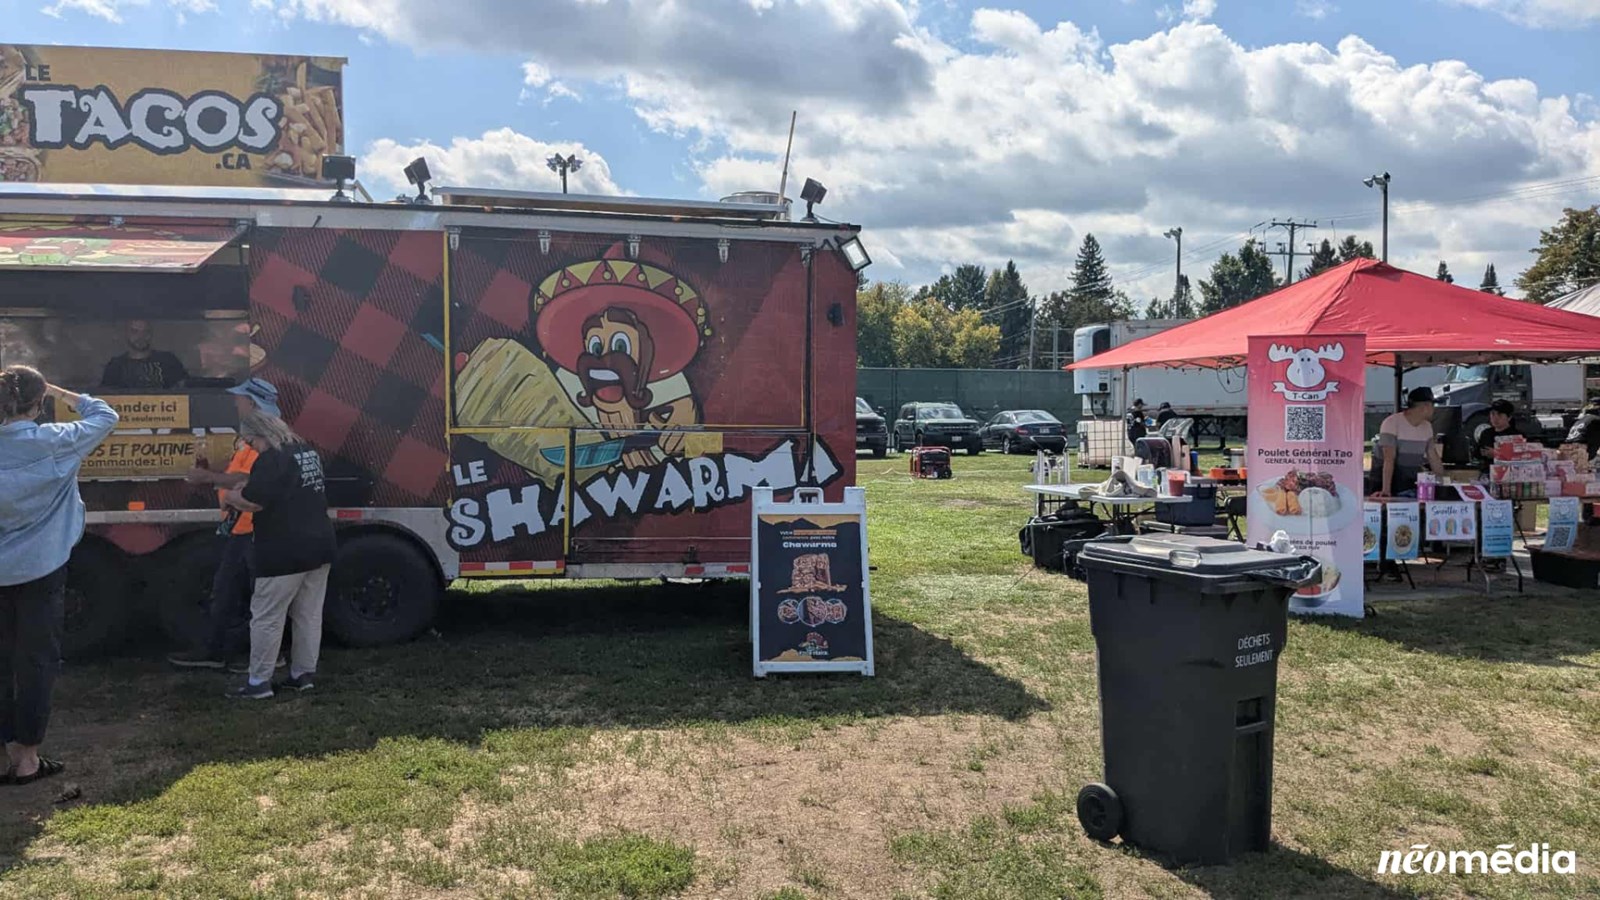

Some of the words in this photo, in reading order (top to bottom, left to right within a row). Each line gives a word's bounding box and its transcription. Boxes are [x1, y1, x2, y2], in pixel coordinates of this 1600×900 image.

[25, 64, 51, 81] LE
[23, 88, 279, 149] TACOS
[215, 155, 251, 170] .CA
[1292, 392, 1319, 400] T-Can
[160, 401, 177, 413] ici
[109, 443, 129, 457] ET
[131, 443, 195, 457] POUTINE
[1258, 449, 1290, 457] Poulet
[1292, 448, 1331, 458] Général
[1333, 449, 1353, 458] Tao
[159, 457, 174, 466] ici
[453, 460, 488, 486] LE
[1237, 633, 1271, 650] DÉCHETS
[1234, 650, 1273, 668] SEULEMENT
